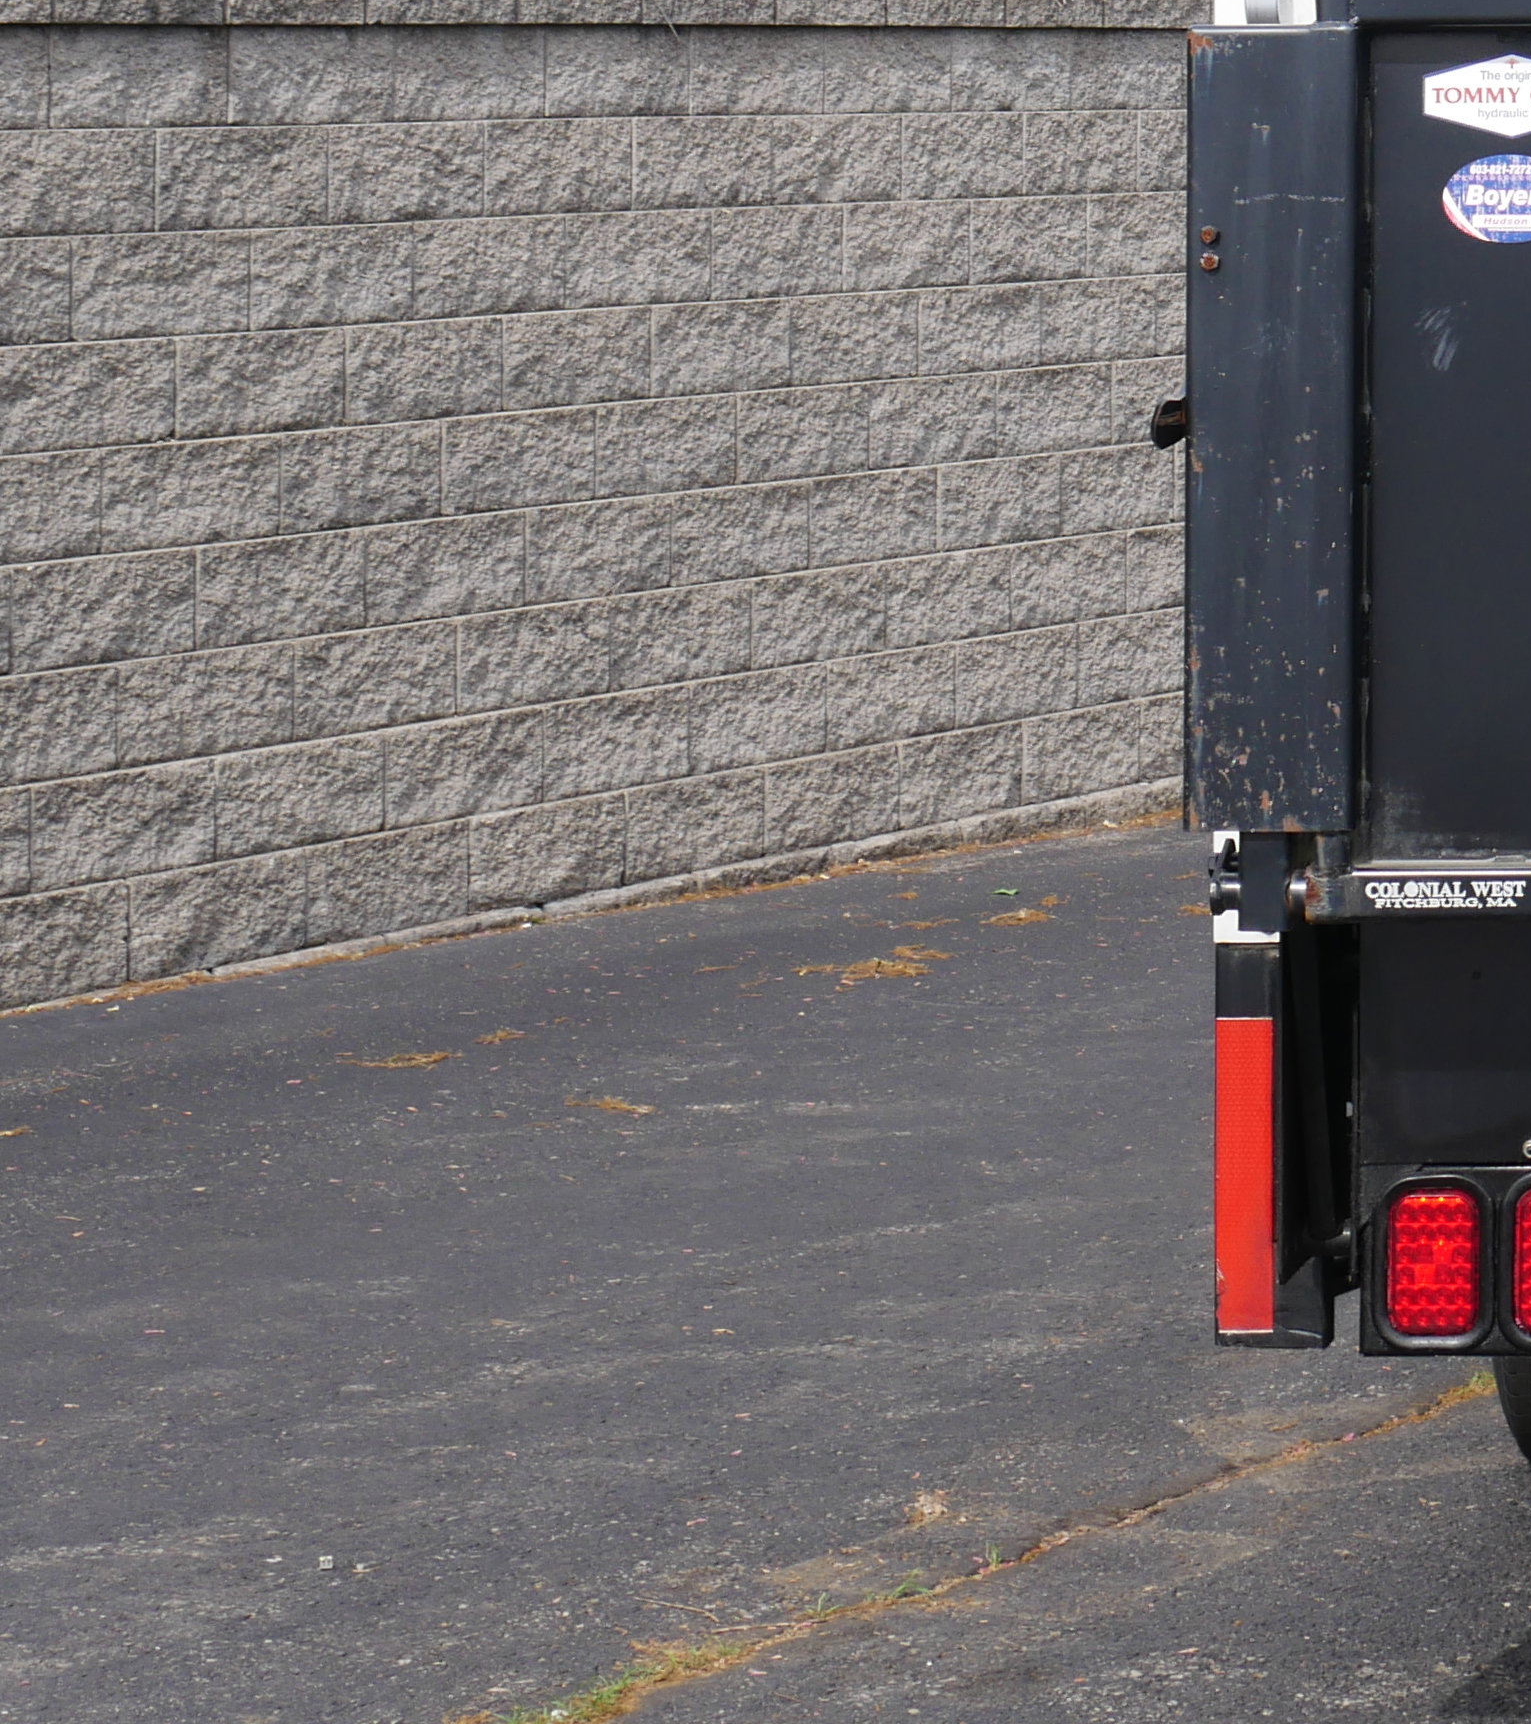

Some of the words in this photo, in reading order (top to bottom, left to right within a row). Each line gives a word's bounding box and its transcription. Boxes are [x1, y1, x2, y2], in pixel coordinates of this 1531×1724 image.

[1480, 70, 1501, 81] The
[1432, 87, 1520, 104] TOMMY
[1477, 108, 1529, 119] hydraulic
[1483, 217, 1528, 225] Hudson
[1364, 880, 1467, 898] COLONIAL
[1471, 880, 1527, 897] WEST
[1374, 897, 1483, 909] FITCHBURG,
[1485, 897, 1518, 908] MA
